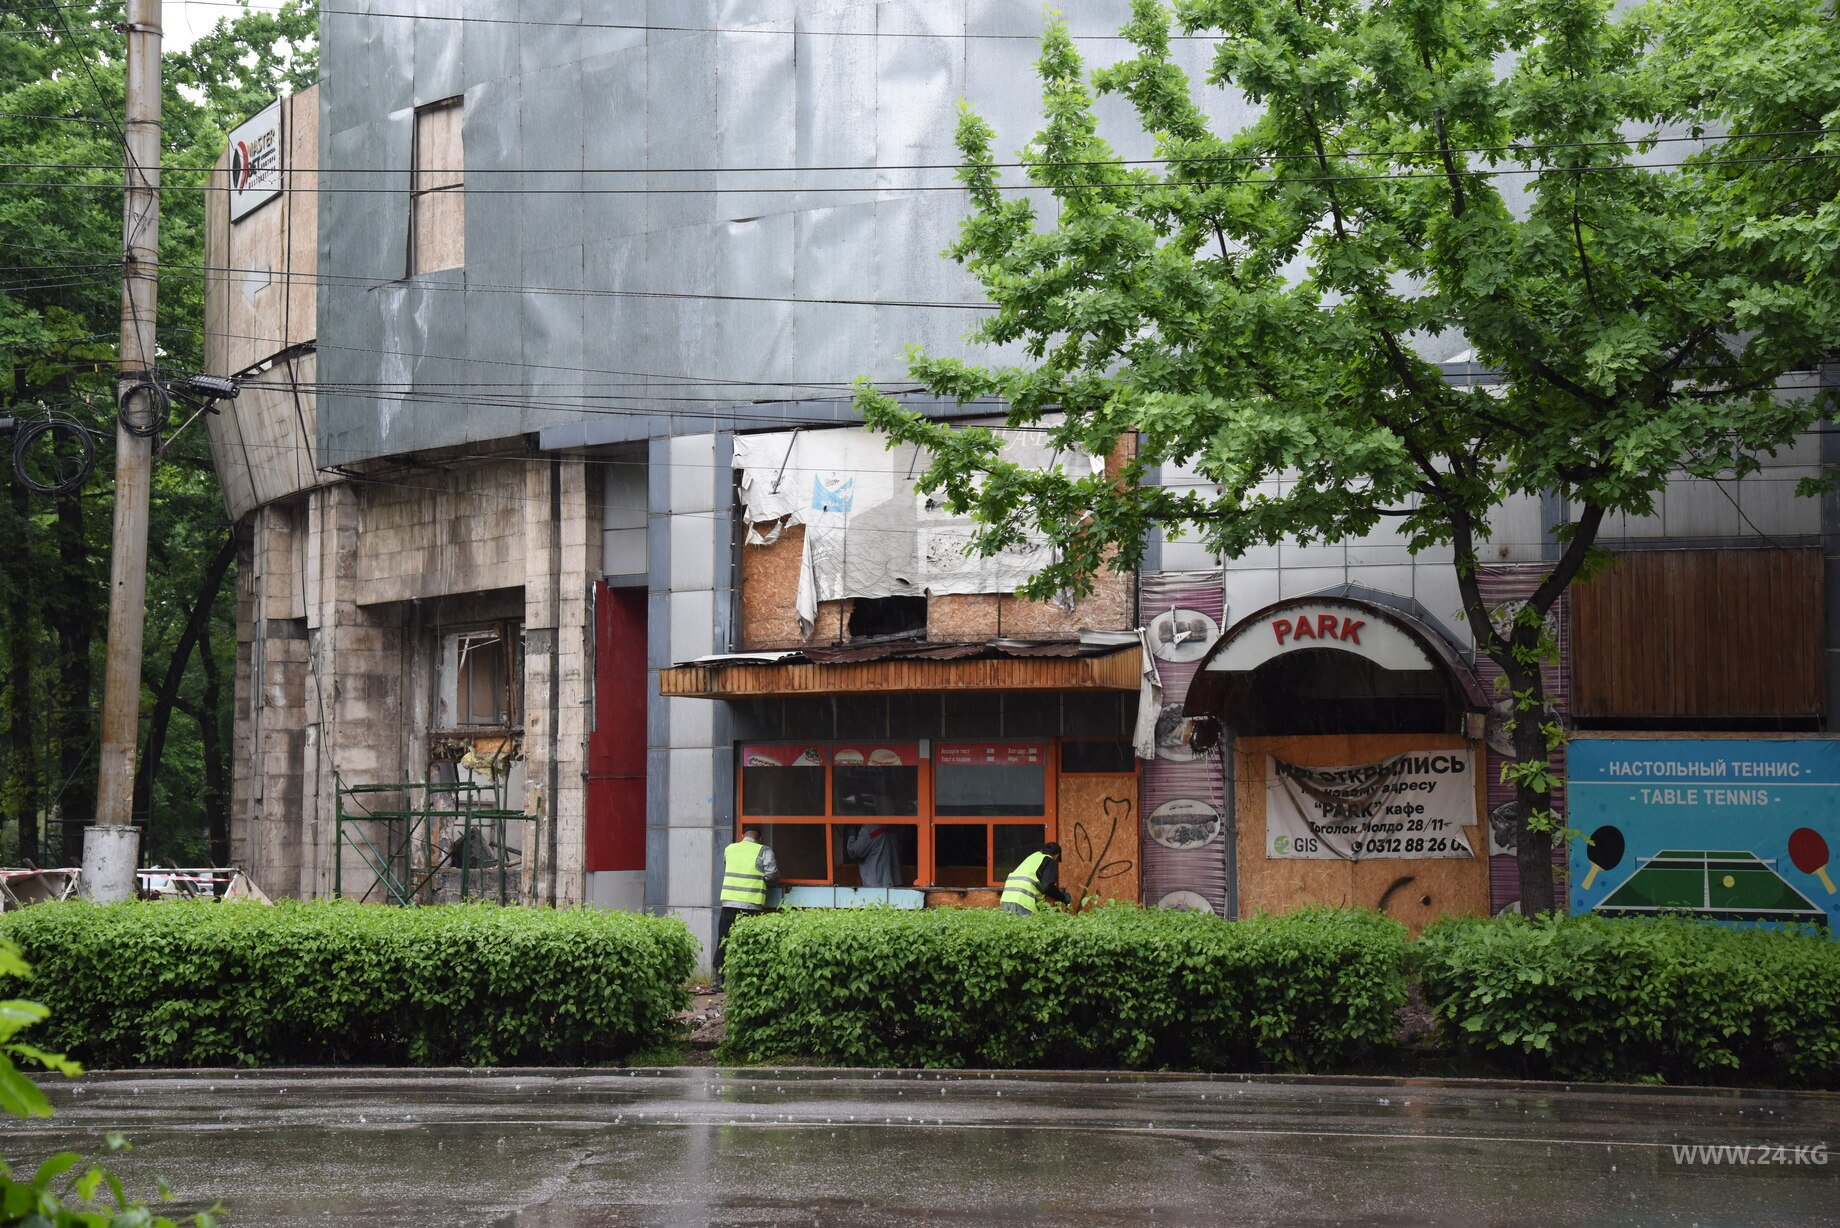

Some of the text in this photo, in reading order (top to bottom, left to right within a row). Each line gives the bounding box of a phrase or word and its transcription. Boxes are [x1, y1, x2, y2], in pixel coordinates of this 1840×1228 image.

[1272, 614, 1367, 646] PARK
[1609, 758, 1726, 777] НАСТОЛЬНЫЙ
[1732, 762, 1800, 777] ТЕННИС
[1382, 780, 1437, 794] адресу
[1641, 789, 1698, 805] TABLE
[1704, 790, 1768, 806] TENNIS
[1386, 802, 1425, 817] кафе
[1309, 821, 1358, 835] Тоголок
[1359, 822, 1404, 834] Молдо
[1294, 838, 1318, 852] GIS
[1366, 838, 1402, 853] 0312
[1405, 838, 1425, 852] 88
[1428, 838, 1447, 852] 26
